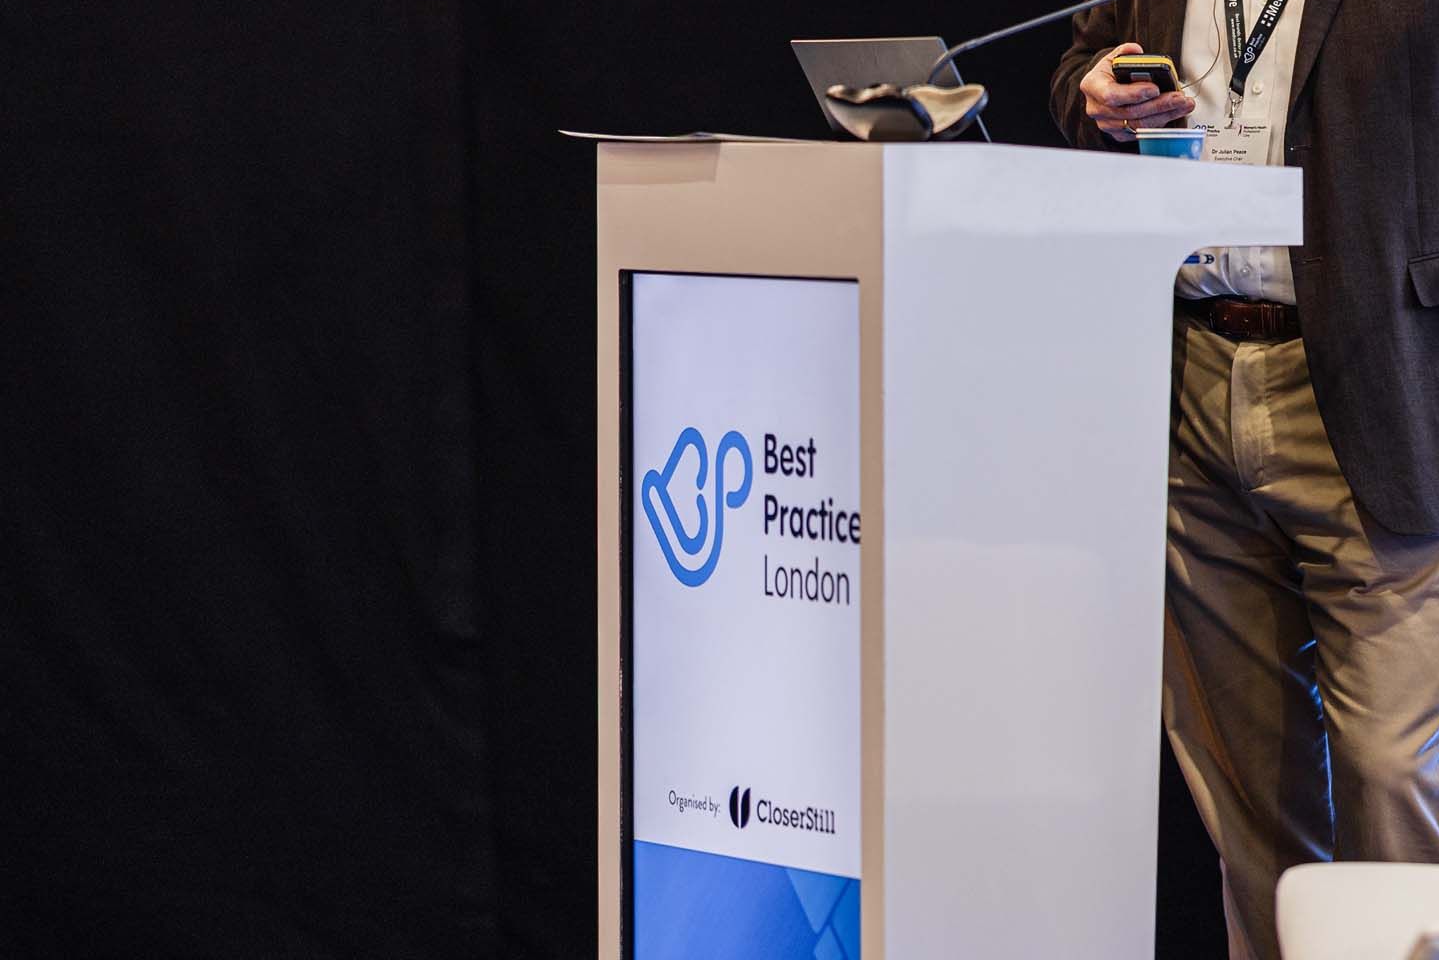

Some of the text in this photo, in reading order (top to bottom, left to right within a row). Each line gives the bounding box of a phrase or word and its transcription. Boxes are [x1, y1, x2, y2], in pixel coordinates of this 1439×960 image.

[764, 433, 817, 478] Best
[764, 494, 861, 544] Practice
[764, 554, 850, 605] London
[668, 789, 721, 818] Organised by:
[756, 799, 836, 834] CloserStill
